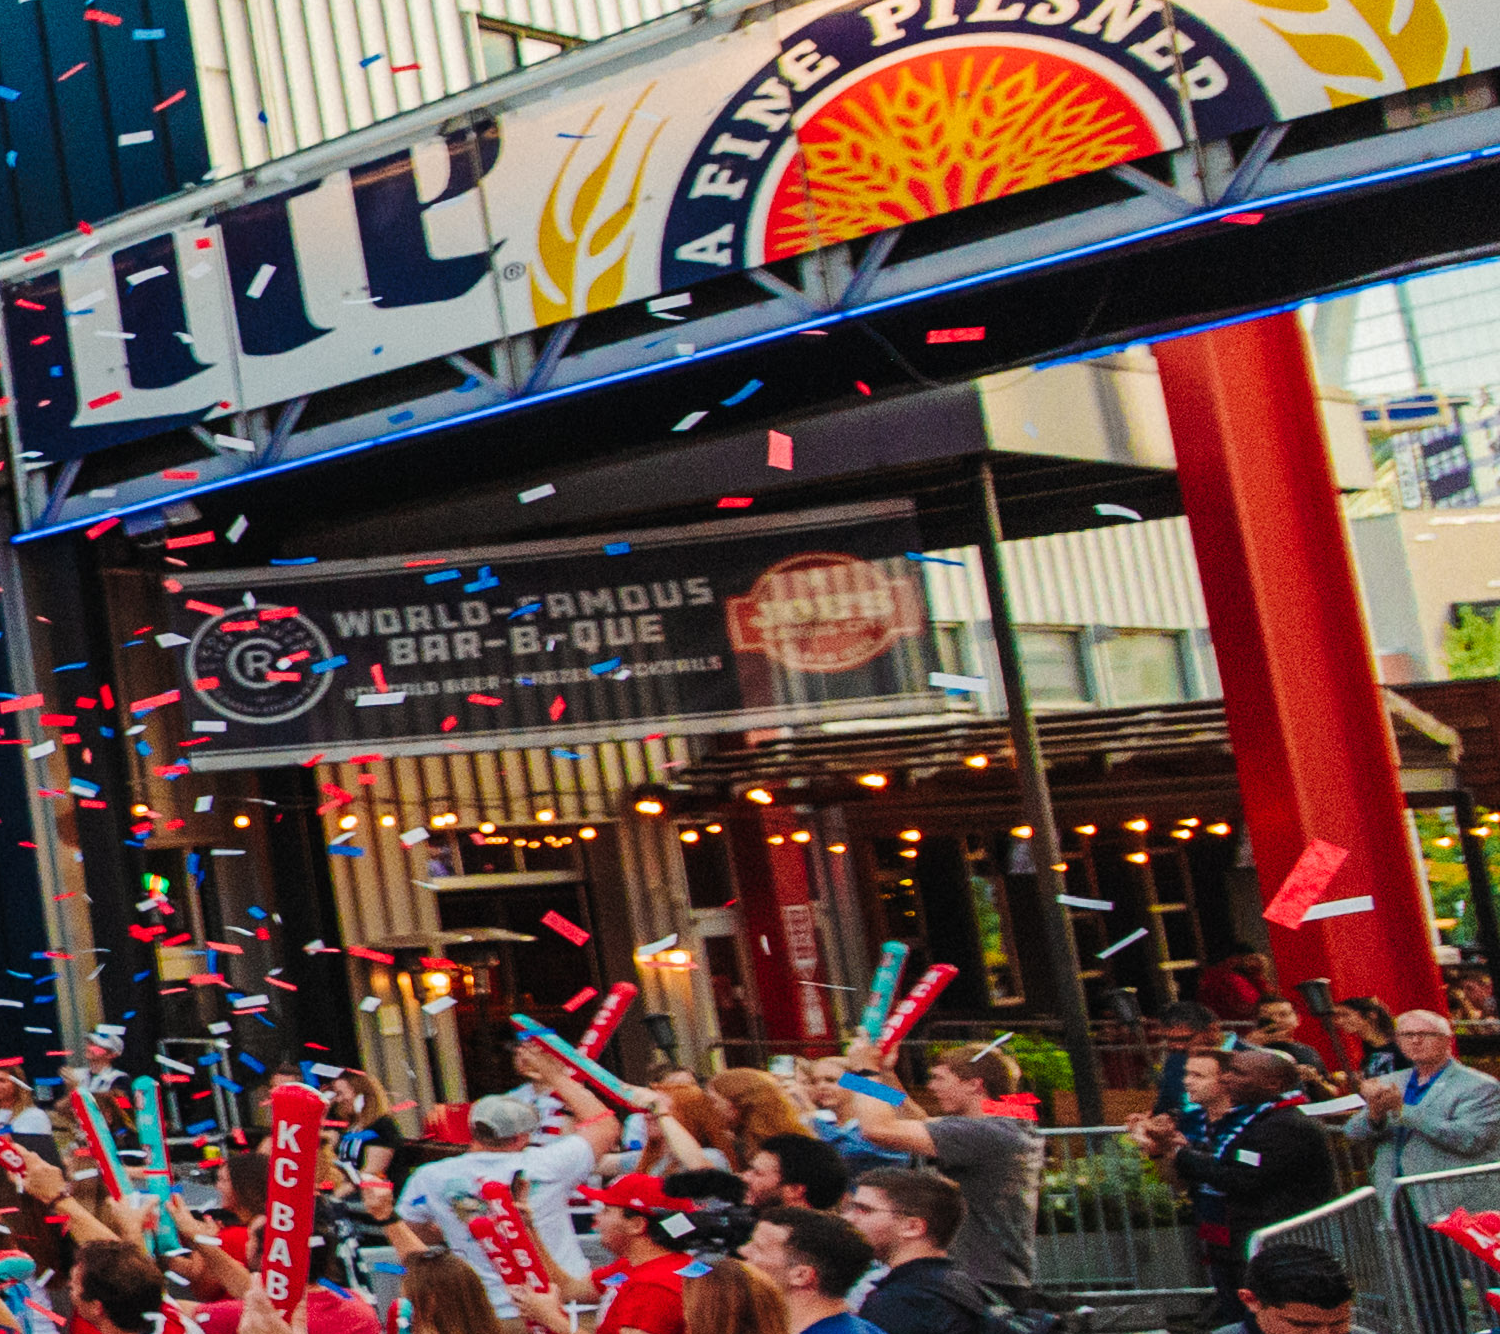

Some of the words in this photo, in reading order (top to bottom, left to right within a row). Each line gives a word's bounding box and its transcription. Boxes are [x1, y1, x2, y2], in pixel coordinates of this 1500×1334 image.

[675, 240, 733, 268] A
[709, 39, 840, 200] FINE
[387, 613, 666, 667] BAR-B-QUE
[271, 1121, 302, 1189] KC
